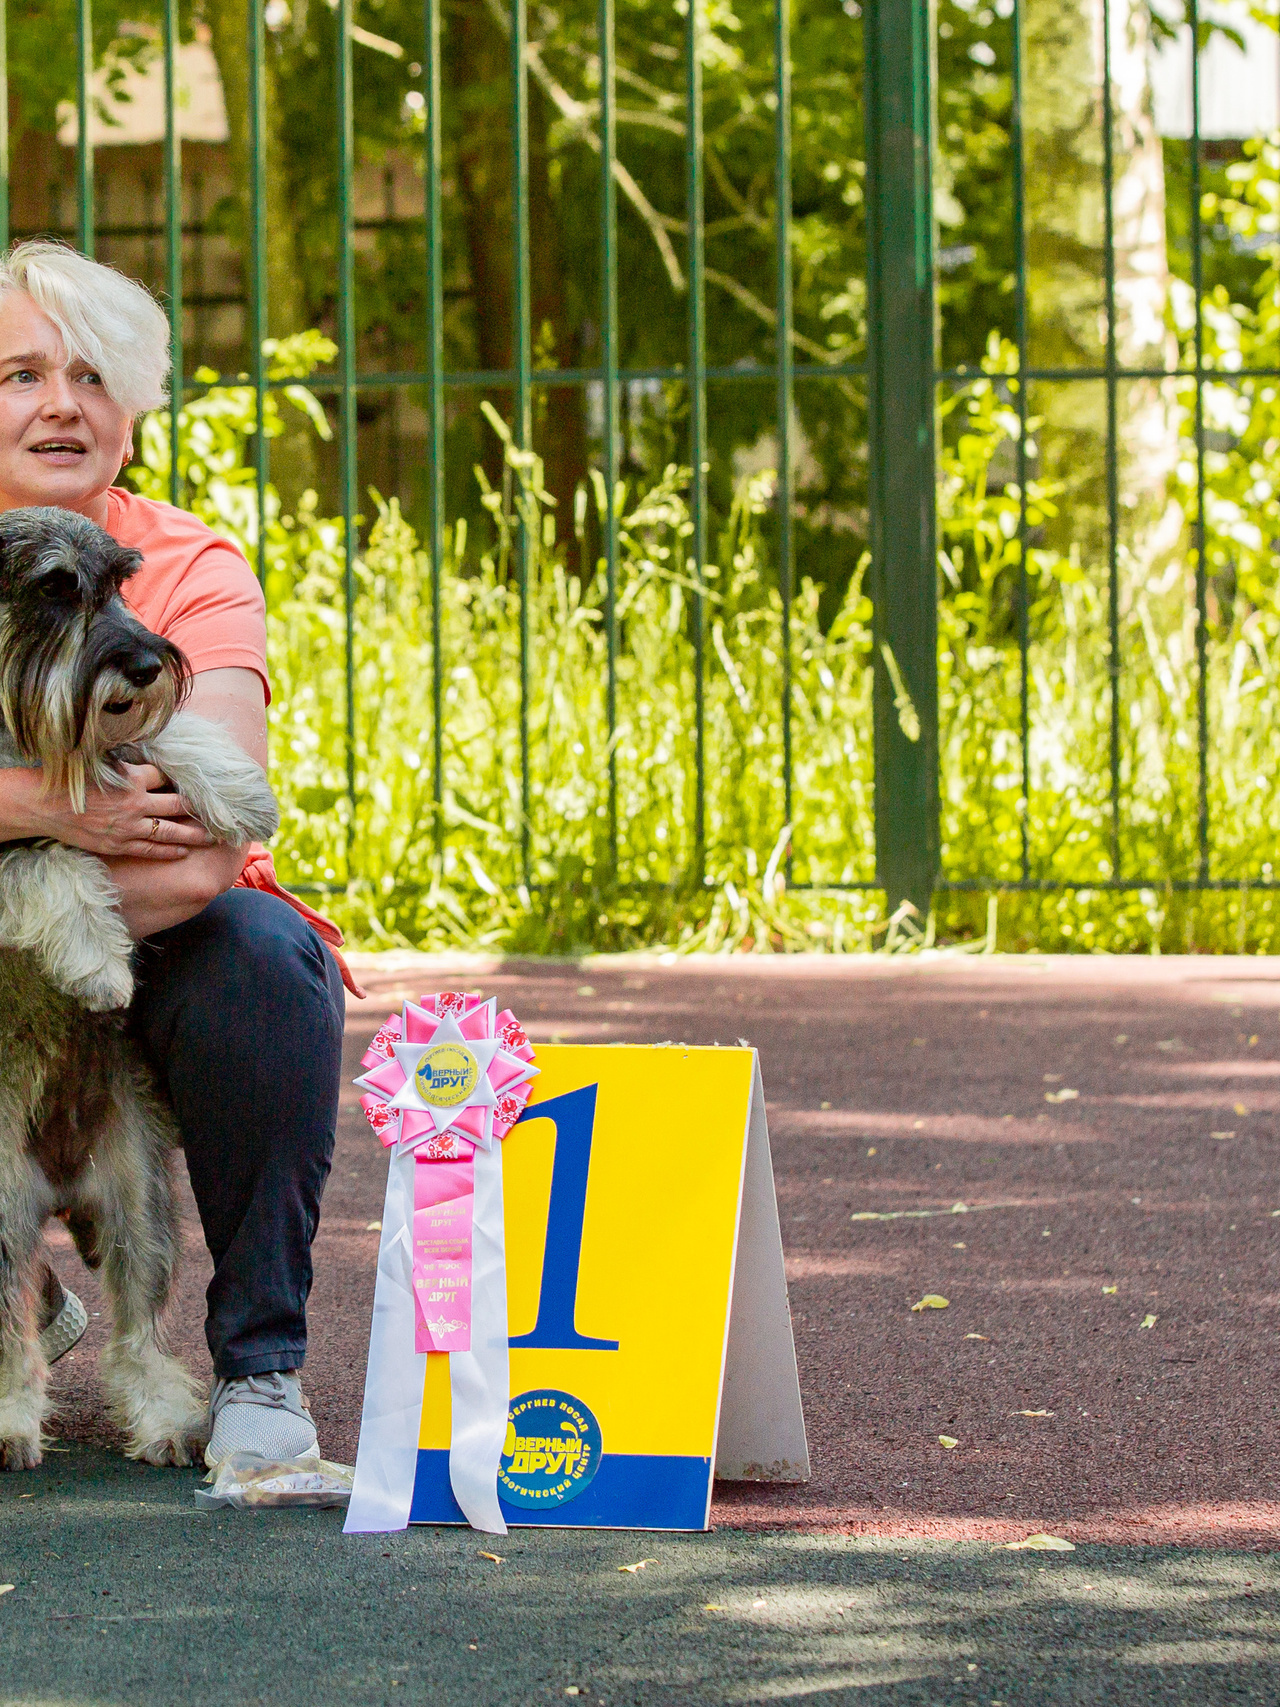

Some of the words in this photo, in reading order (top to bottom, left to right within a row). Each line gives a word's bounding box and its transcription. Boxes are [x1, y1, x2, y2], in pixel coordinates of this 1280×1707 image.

[432, 1068, 469, 1076] ВЕРНЫЙ
[429, 1075, 469, 1089] ДРУГ
[508, 1082, 620, 1352] 1
[415, 1275, 469, 1289] ВЕРНЫЙ
[427, 1291, 458, 1303] ДРУГ
[559, 1401, 589, 1433] ПОСАД
[515, 1436, 583, 1453] ВЕРНЫЙ
[498, 1464, 572, 1498] ОЛОГИЧЕСКИЙ
[571, 1443, 592, 1480] ЦЕНТР
[506, 1452, 582, 1475] ДРУГ
